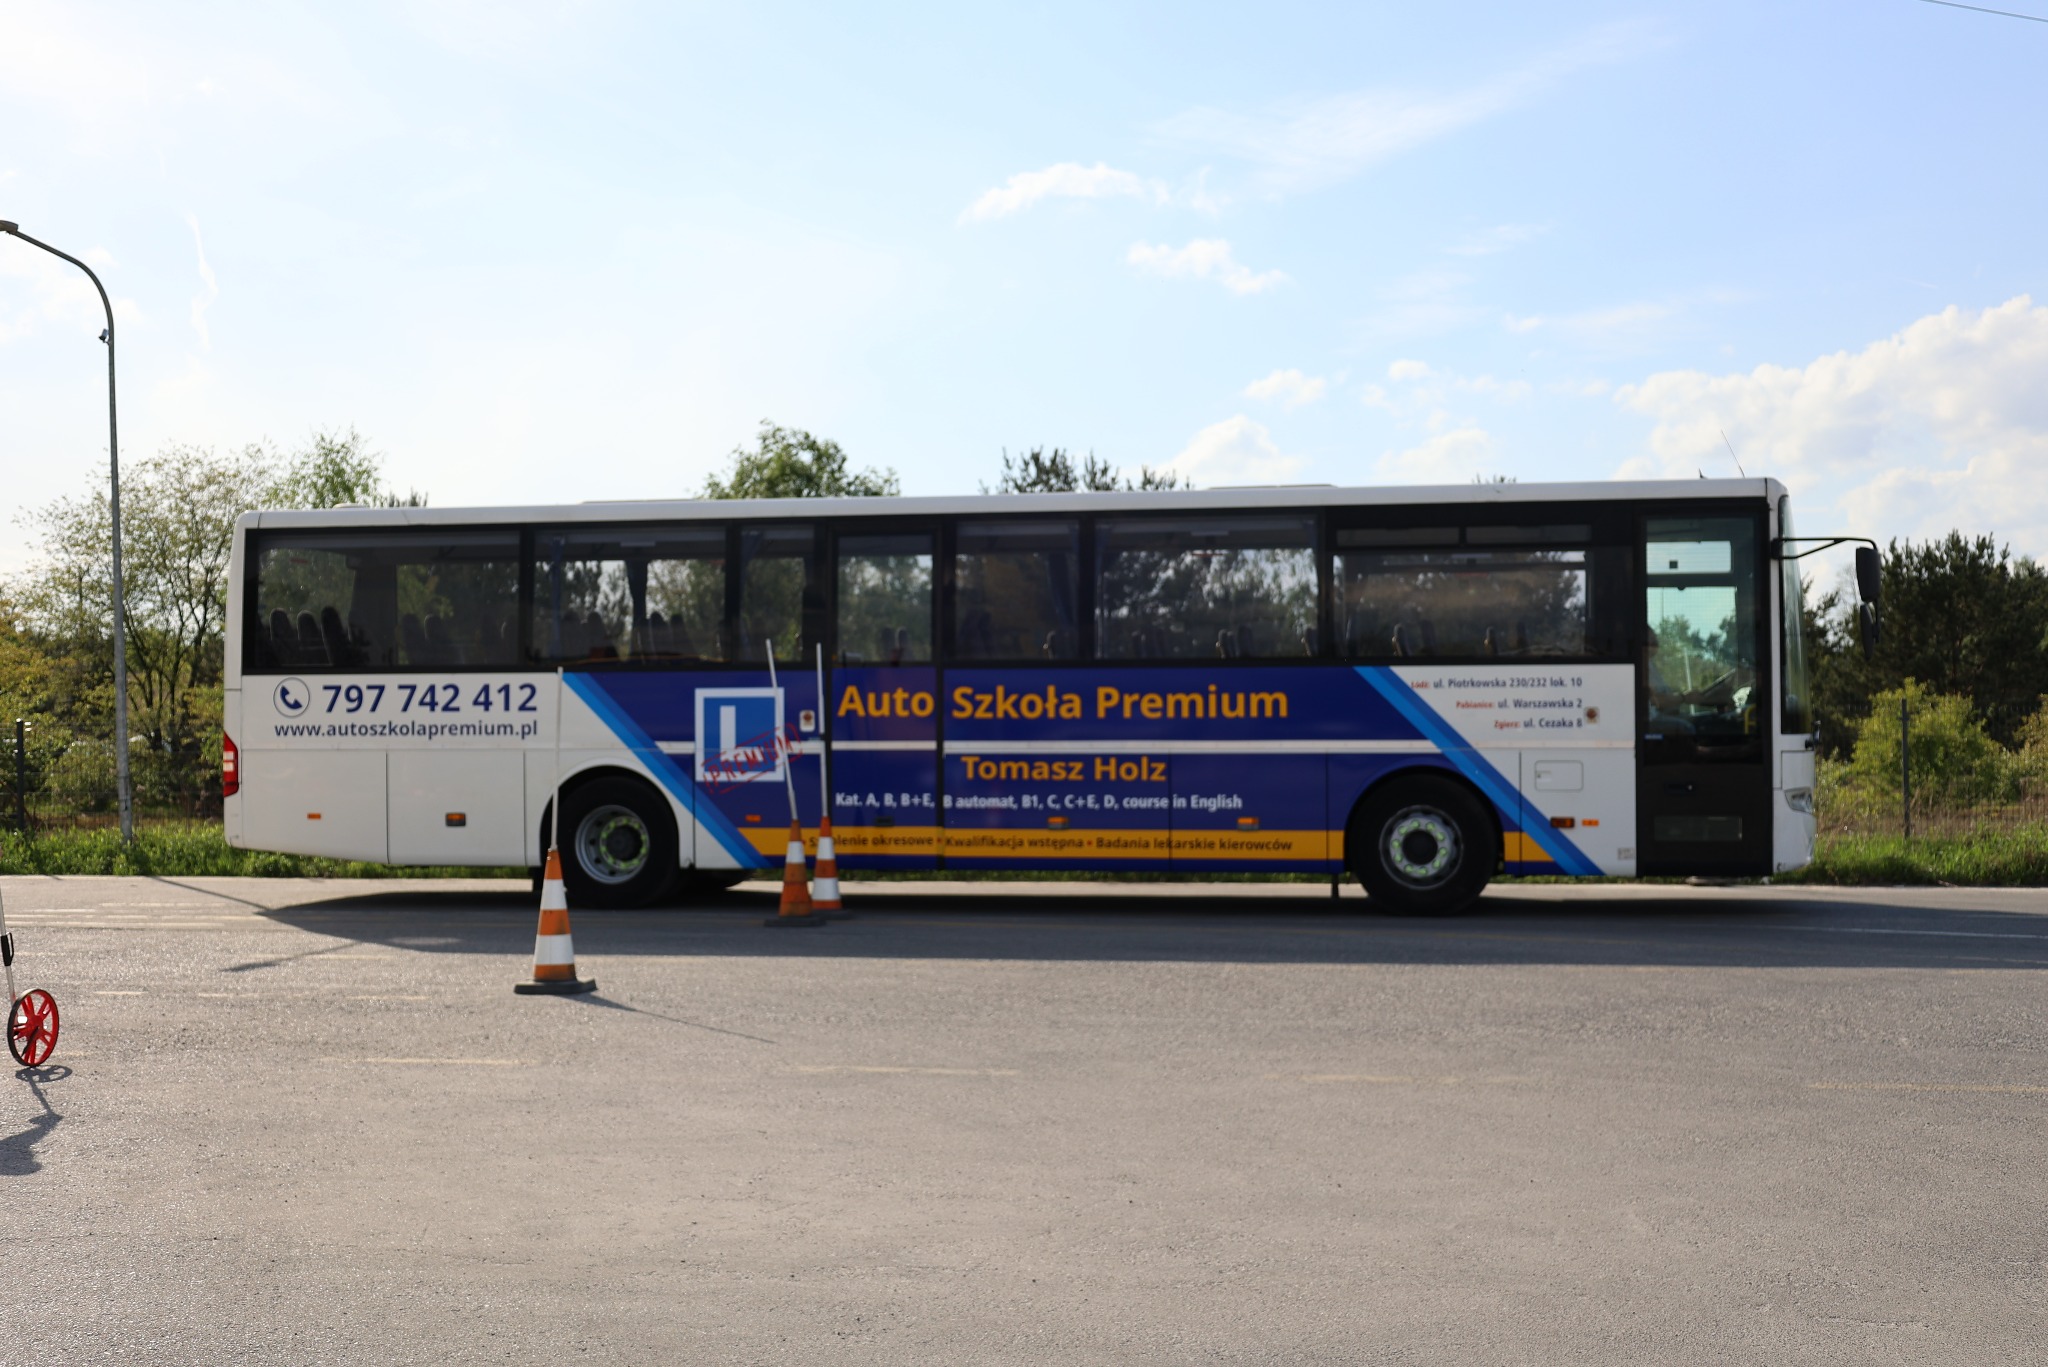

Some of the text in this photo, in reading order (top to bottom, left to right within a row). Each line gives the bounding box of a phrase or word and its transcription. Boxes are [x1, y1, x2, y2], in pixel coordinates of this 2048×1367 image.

[1433, 679, 1444, 688] ul.
[1550, 677, 1568, 688] lok.
[1571, 677, 1583, 687] 10
[322, 683, 538, 713] 797 742 412
[838, 684, 1289, 718] Auto Szkoła Premium
[1498, 699, 1510, 709] ul.
[1576, 698, 1583, 708] 2
[274, 720, 538, 740] www.autoszkolapremium.pl
[1523, 719, 1536, 728] ul.
[1576, 718, 1583, 728] 8
[720, 706, 765, 762] L
[961, 755, 1167, 781] Tomasz Holz
[835, 792, 863, 807] Kat.
[866, 792, 880, 807] A,
[884, 792, 898, 808] B,
[900, 792, 935, 808] B+E,
[943, 794, 953, 808] B
[955, 795, 1018, 810] automat,
[1021, 794, 1044, 809] B1,
[1047, 794, 1061, 809] C,
[1104, 794, 1119, 810] D,
[1122, 797, 1169, 809] course
[1172, 794, 1187, 809] in
[1190, 794, 1243, 813] English
[871, 834, 934, 847] okresowe
[1096, 837, 1150, 849] Badania
